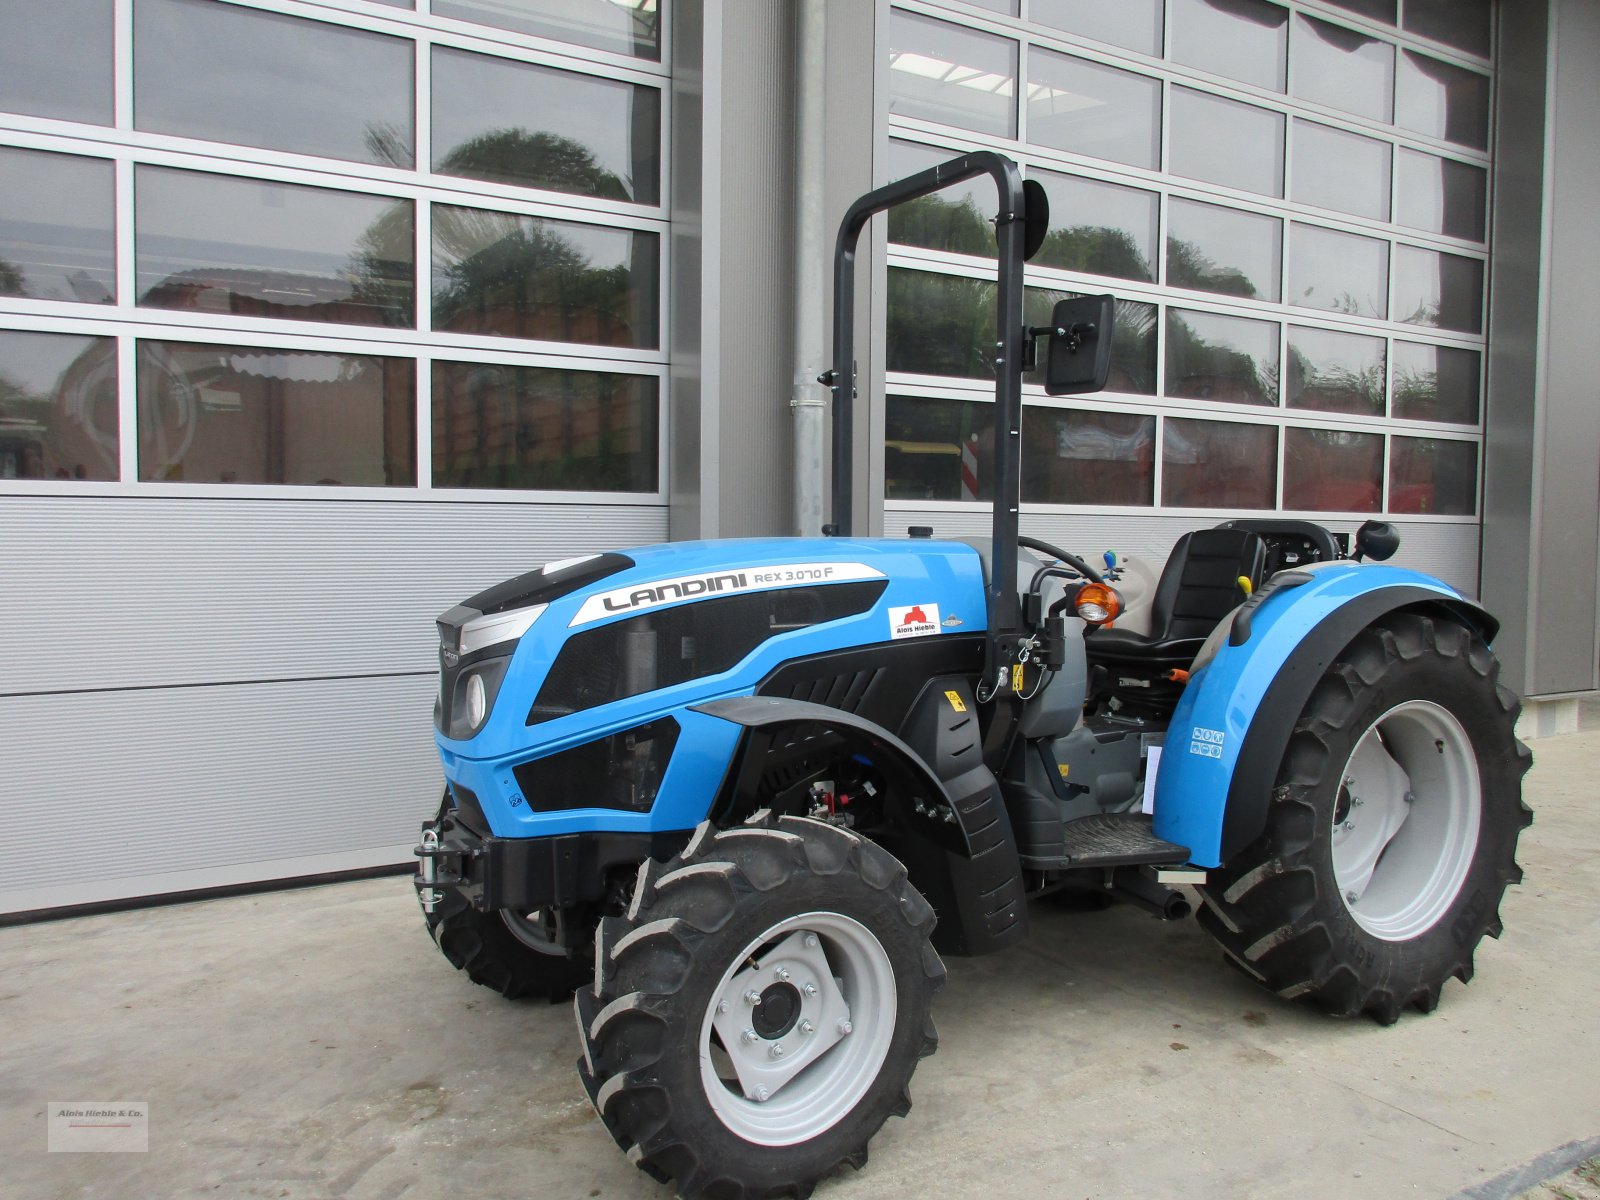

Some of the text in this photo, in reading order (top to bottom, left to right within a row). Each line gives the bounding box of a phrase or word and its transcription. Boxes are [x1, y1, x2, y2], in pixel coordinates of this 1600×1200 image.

[603, 573, 747, 611] LANDINI
[754, 573, 782, 583] REX
[914, 624, 936, 632] Hieble
